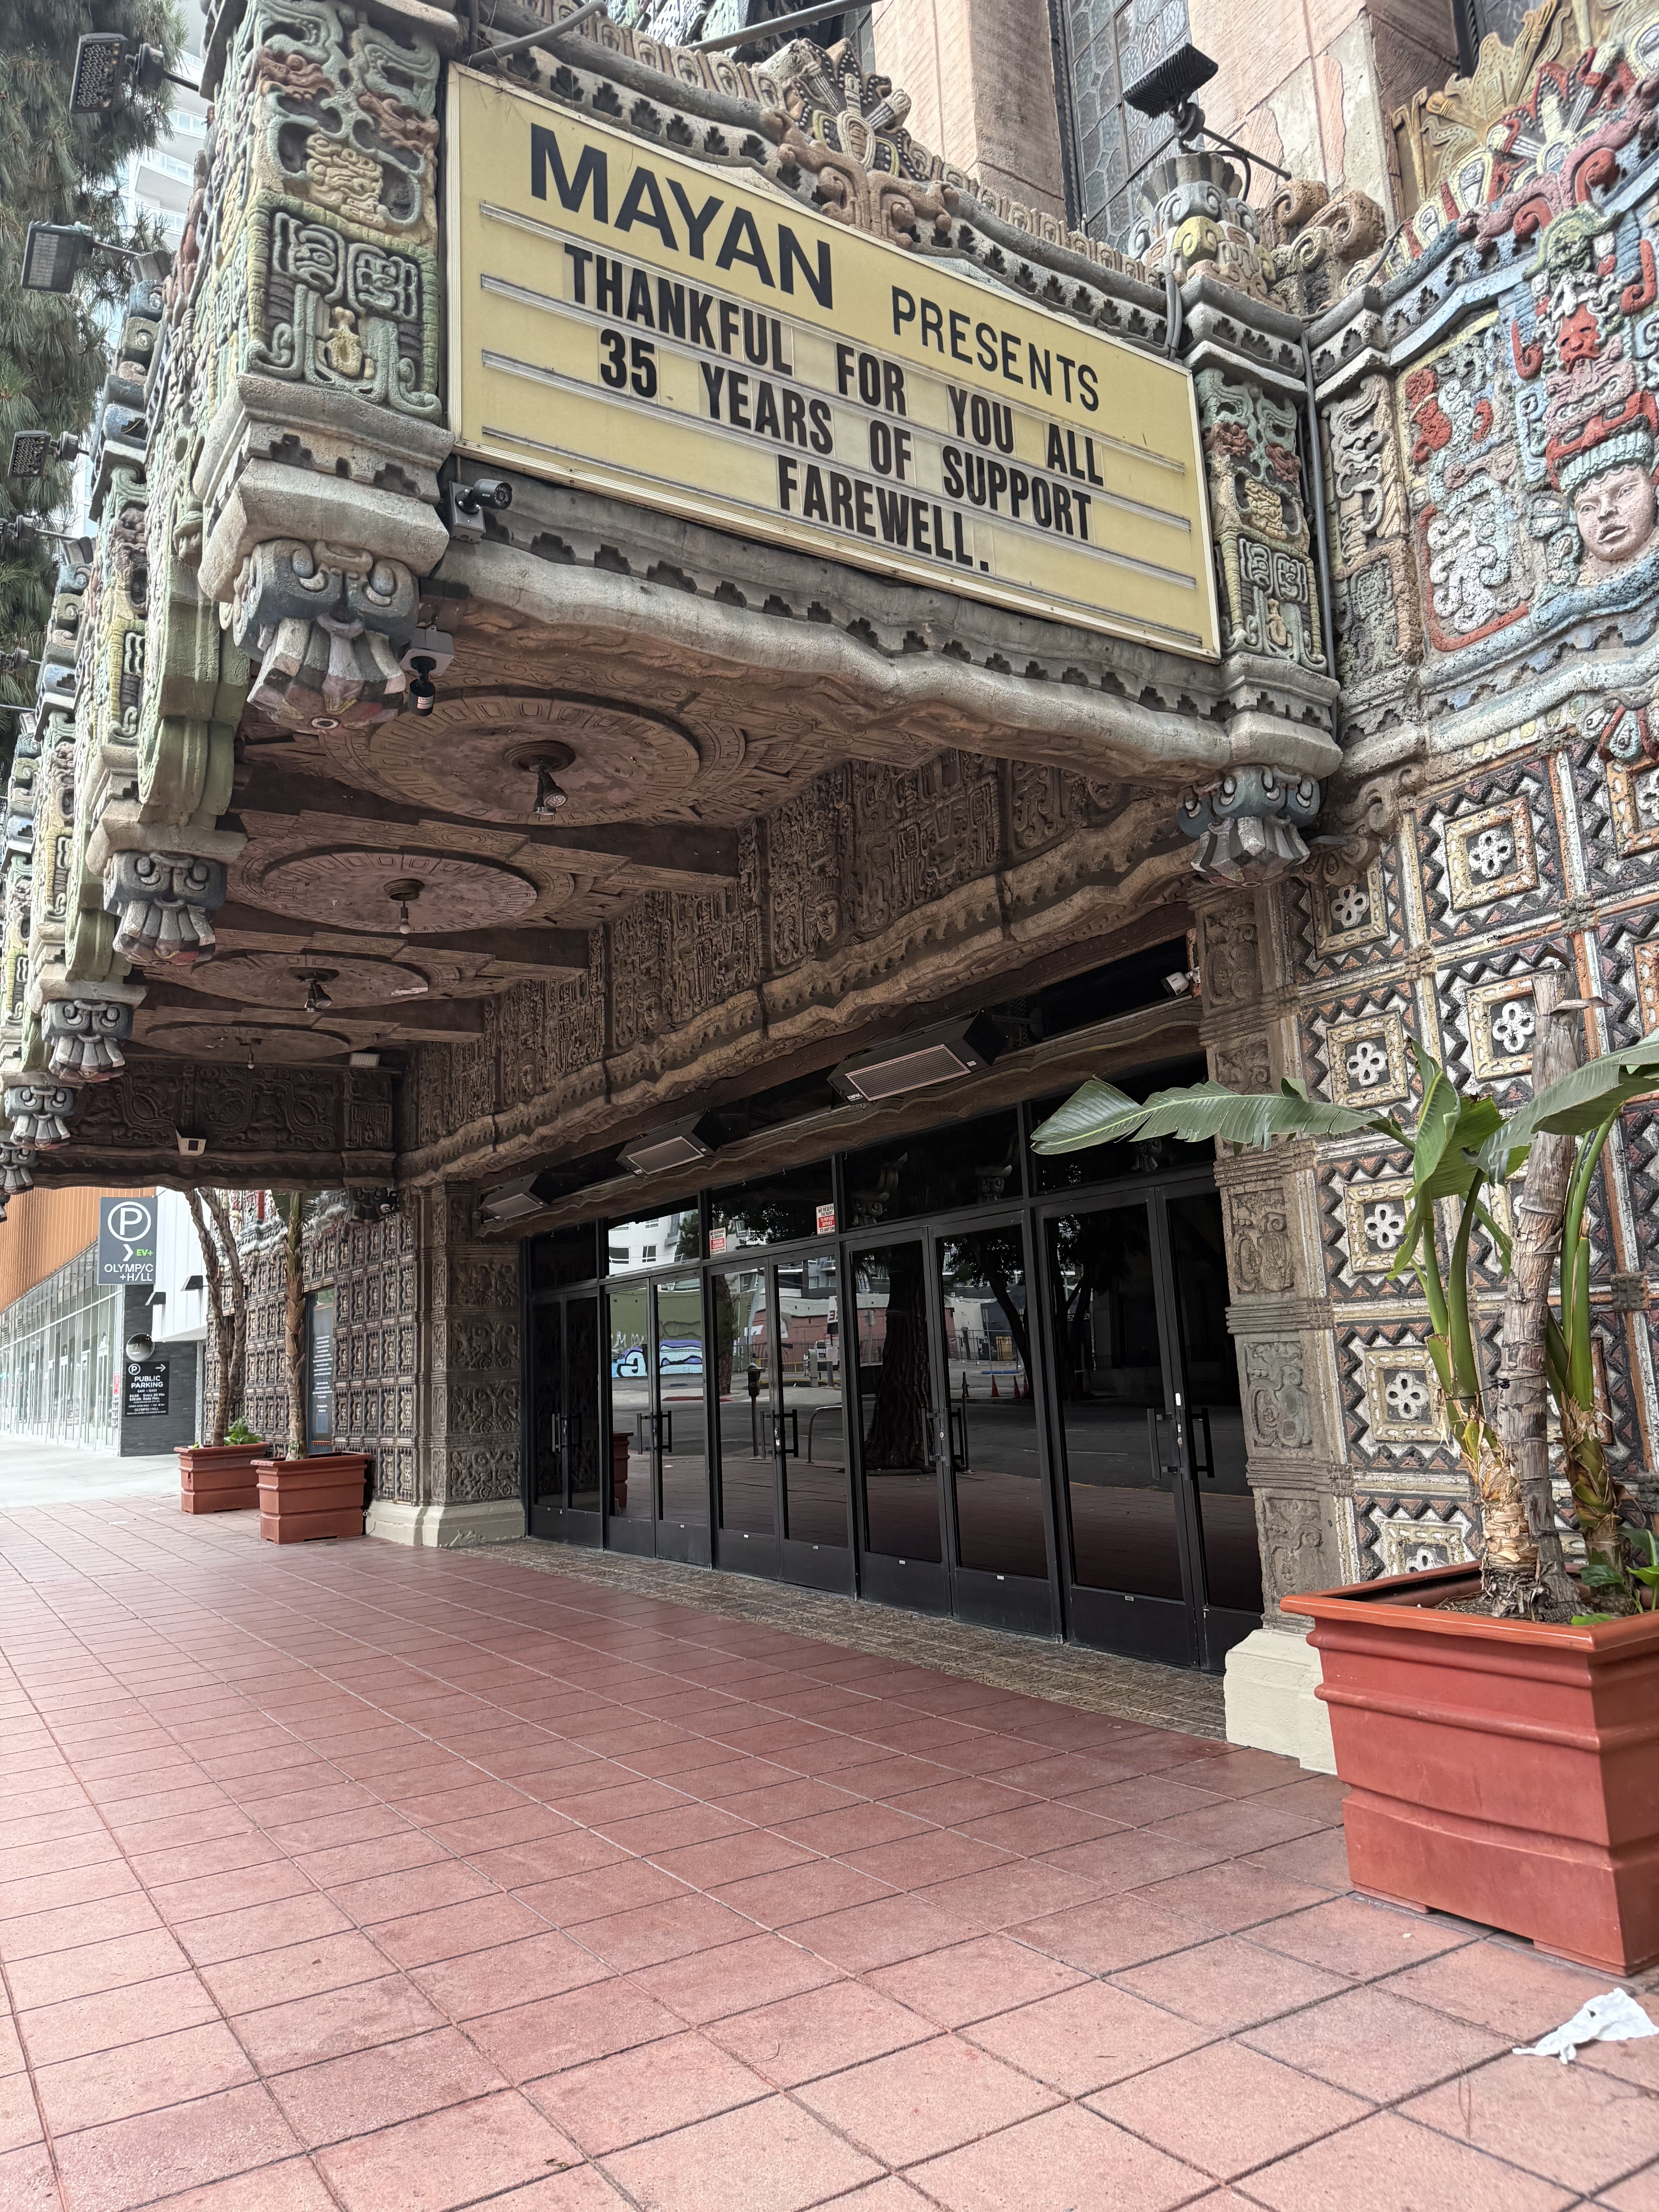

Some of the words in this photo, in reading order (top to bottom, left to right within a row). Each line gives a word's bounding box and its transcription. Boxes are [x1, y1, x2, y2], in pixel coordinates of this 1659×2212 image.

[531, 123, 833, 310] MAYAN
[892, 285, 1099, 412] PRESENTS
[564, 242, 793, 376] THANKFUL
[836, 343, 906, 416] FOR
[948, 385, 1014, 454] YOU
[1047, 423, 1104, 486] ALL
[601, 328, 657, 398] 35
[700, 361, 833, 455] YEARS
[869, 420, 912, 480] OF
[943, 445, 1091, 540] SUPPORT
[778, 454, 989, 572] FAREWELL.
[120, 1207, 143, 1236] P
